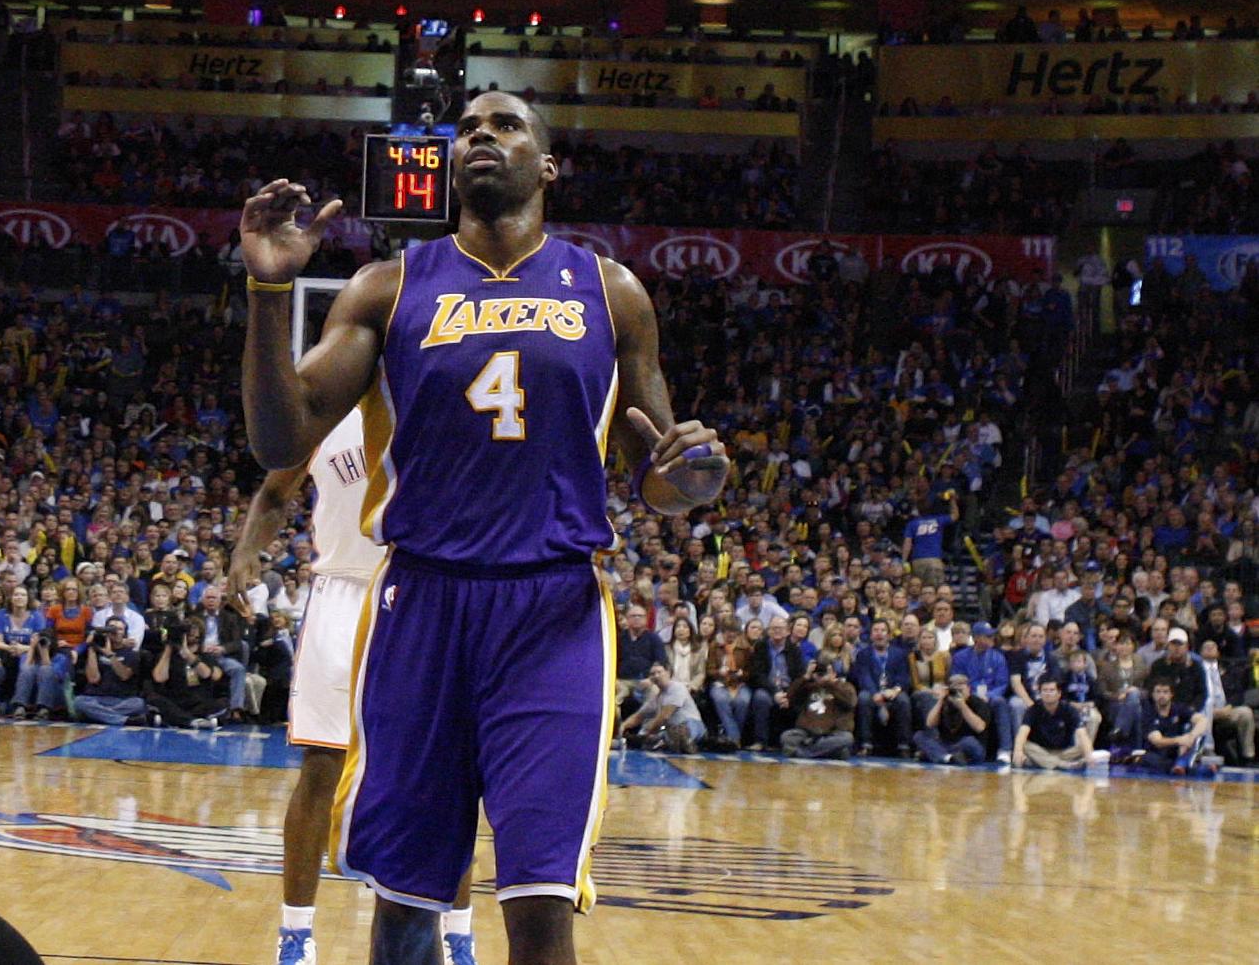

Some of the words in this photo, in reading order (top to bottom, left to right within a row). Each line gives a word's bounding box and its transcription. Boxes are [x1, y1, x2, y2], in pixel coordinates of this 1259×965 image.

[189, 54, 261, 75] Hertz
[1006, 52, 1163, 95] Hertz
[598, 68, 671, 90] Hertz
[389, 146, 440, 170] 4:46
[394, 172, 435, 210] 14
[664, 245, 725, 272] KIA
[1022, 236, 1054, 256] 111
[1146, 237, 1184, 257] 112
[420, 293, 587, 349] LAKERS
[464, 350, 526, 441] 4
